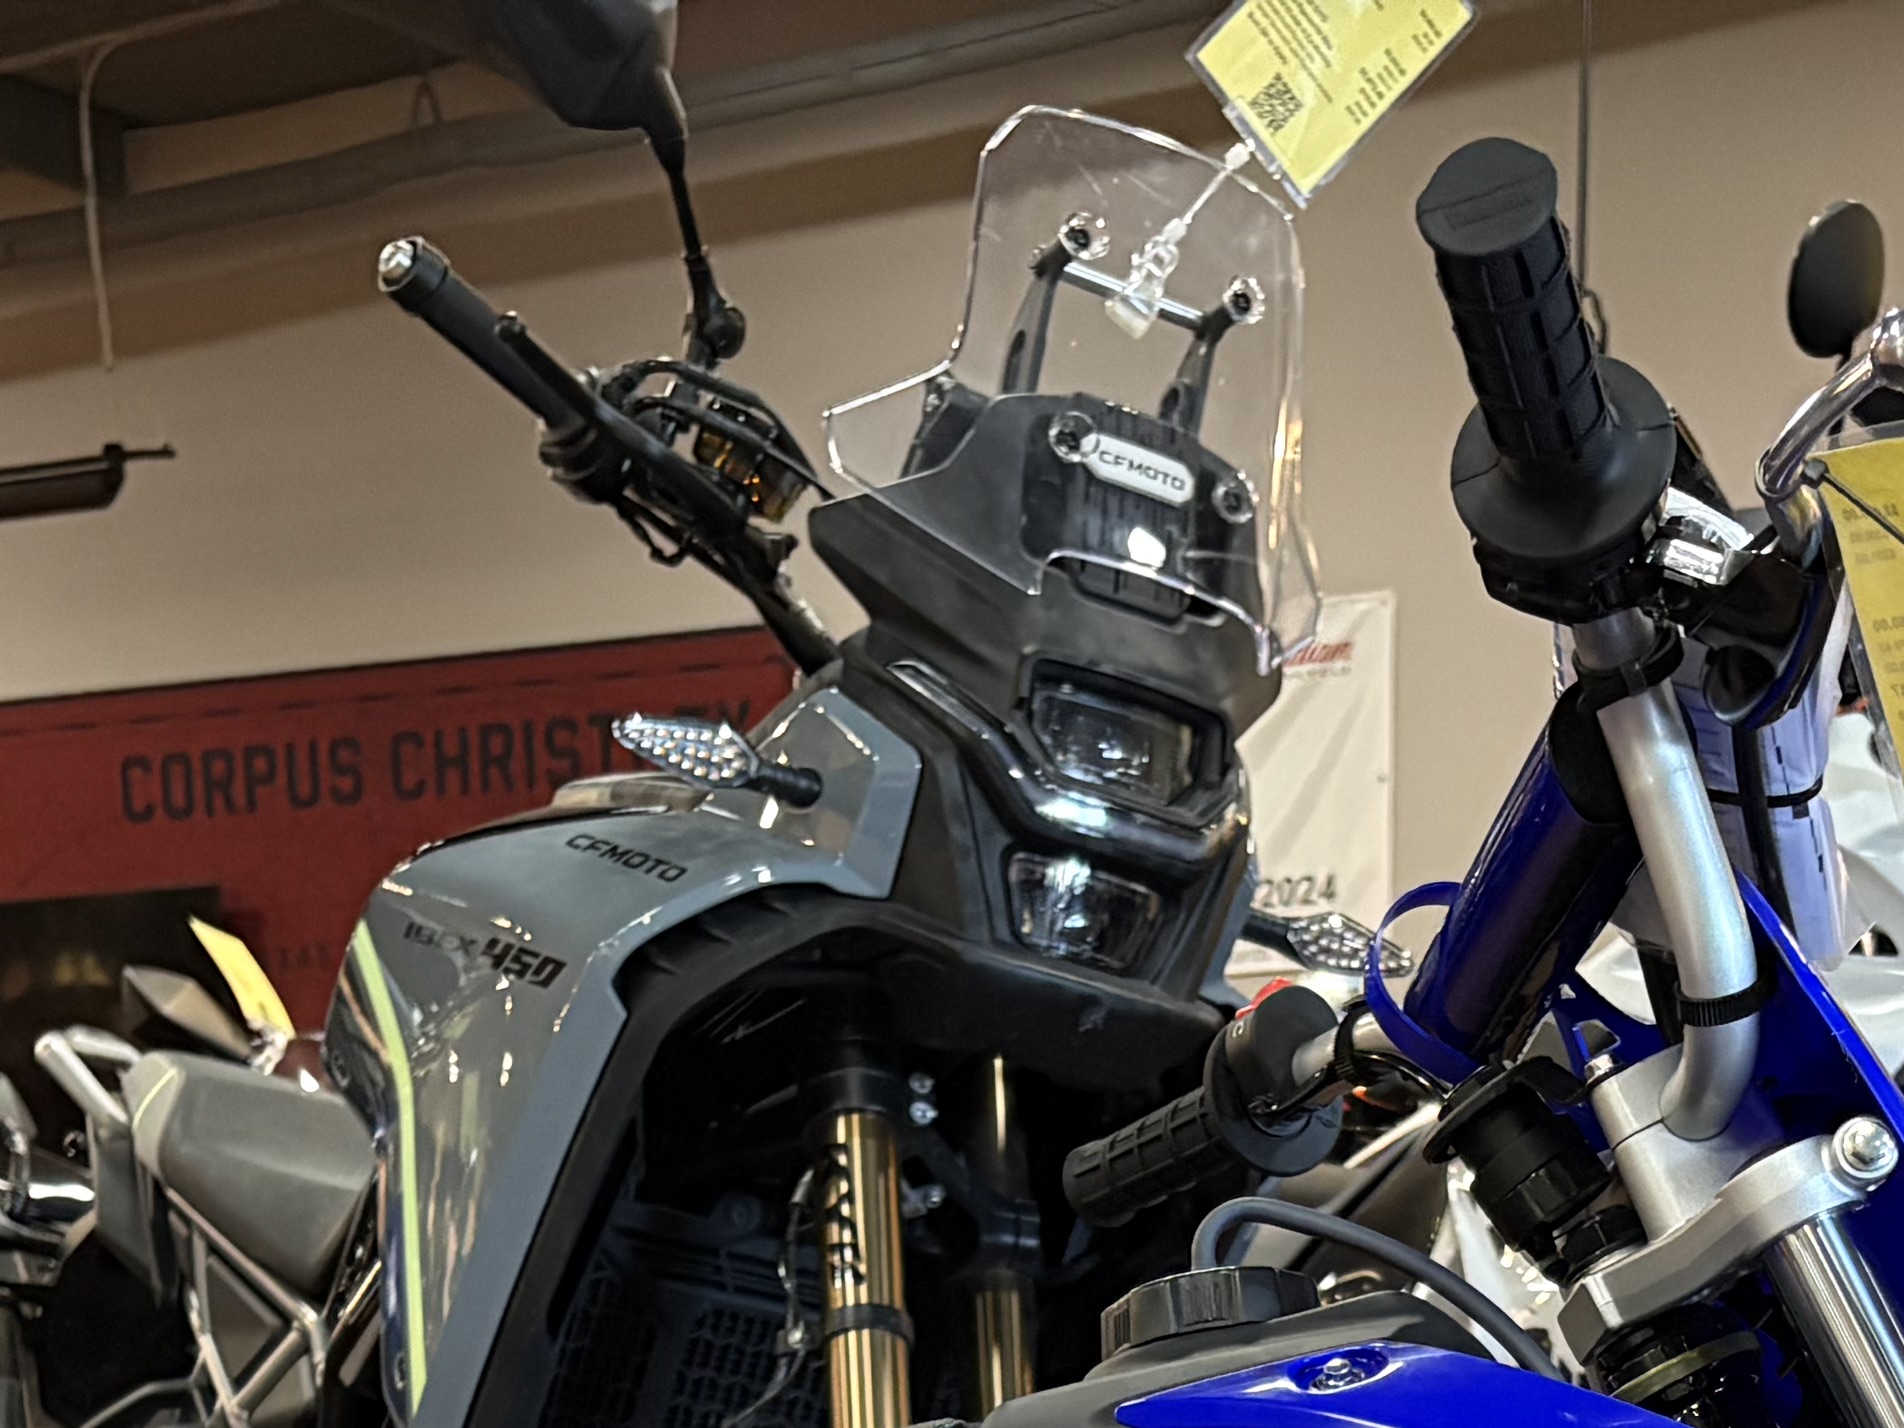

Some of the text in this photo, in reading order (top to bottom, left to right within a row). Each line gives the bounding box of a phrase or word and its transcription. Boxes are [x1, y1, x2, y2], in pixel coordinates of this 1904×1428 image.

[1099, 451, 1186, 491] CFMOTO
[121, 711, 648, 826] CORPUS CHRIST
[565, 833, 688, 883] CFMOTO
[1257, 872, 1337, 909] 2024
[482, 937, 567, 989] 450
